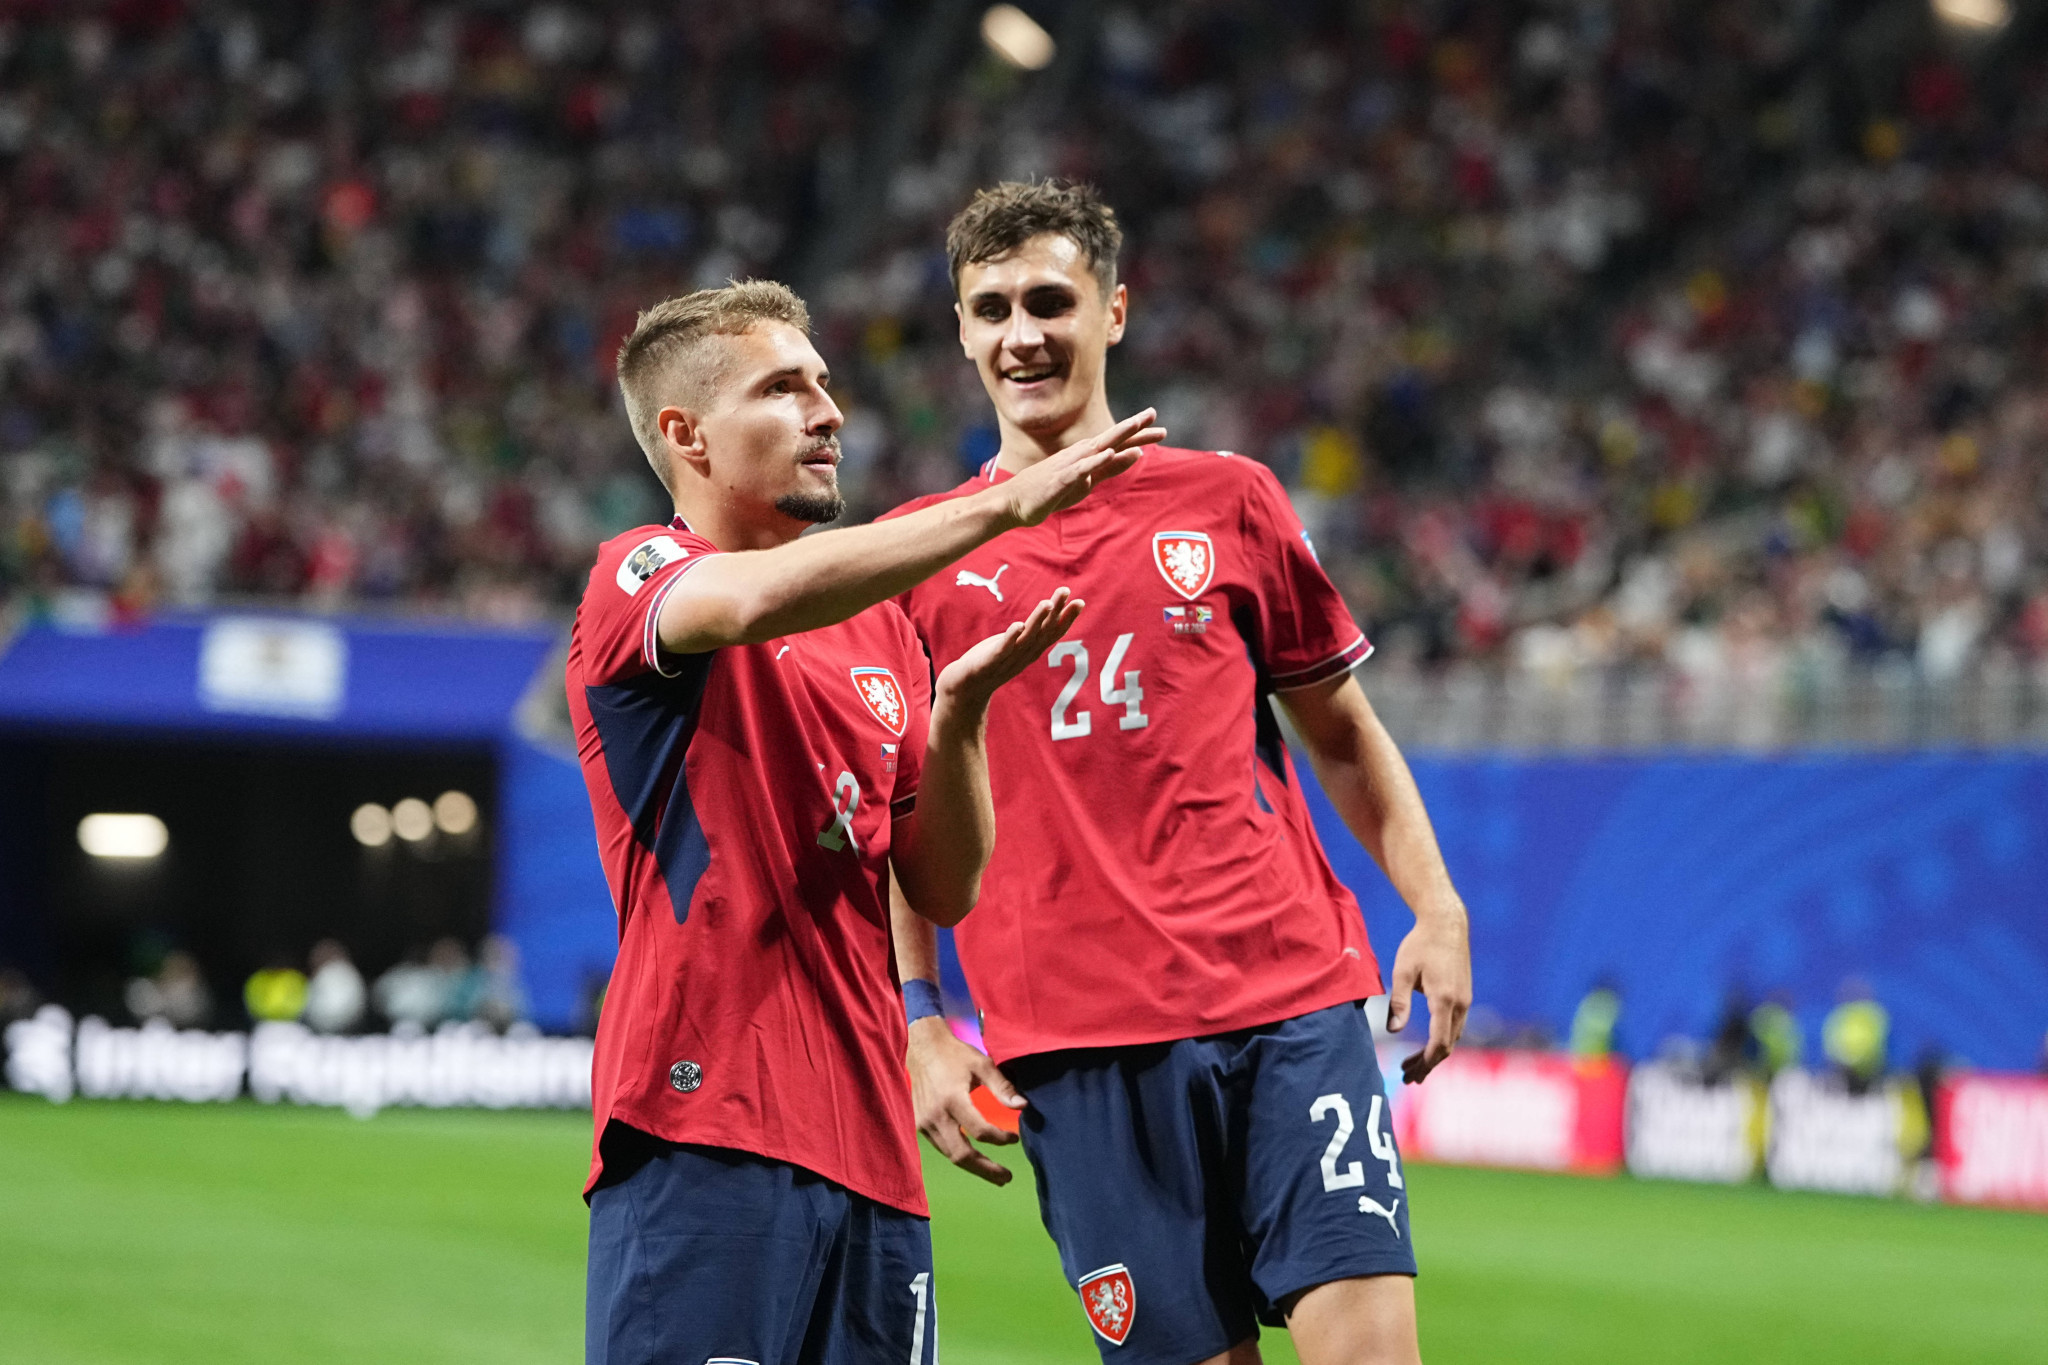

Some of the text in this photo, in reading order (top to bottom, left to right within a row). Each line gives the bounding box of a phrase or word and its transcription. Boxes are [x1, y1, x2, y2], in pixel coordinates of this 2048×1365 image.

[1048, 633, 1148, 741] 24
[1309, 1093, 1403, 1192] 24
[909, 1272, 939, 1365] 1
